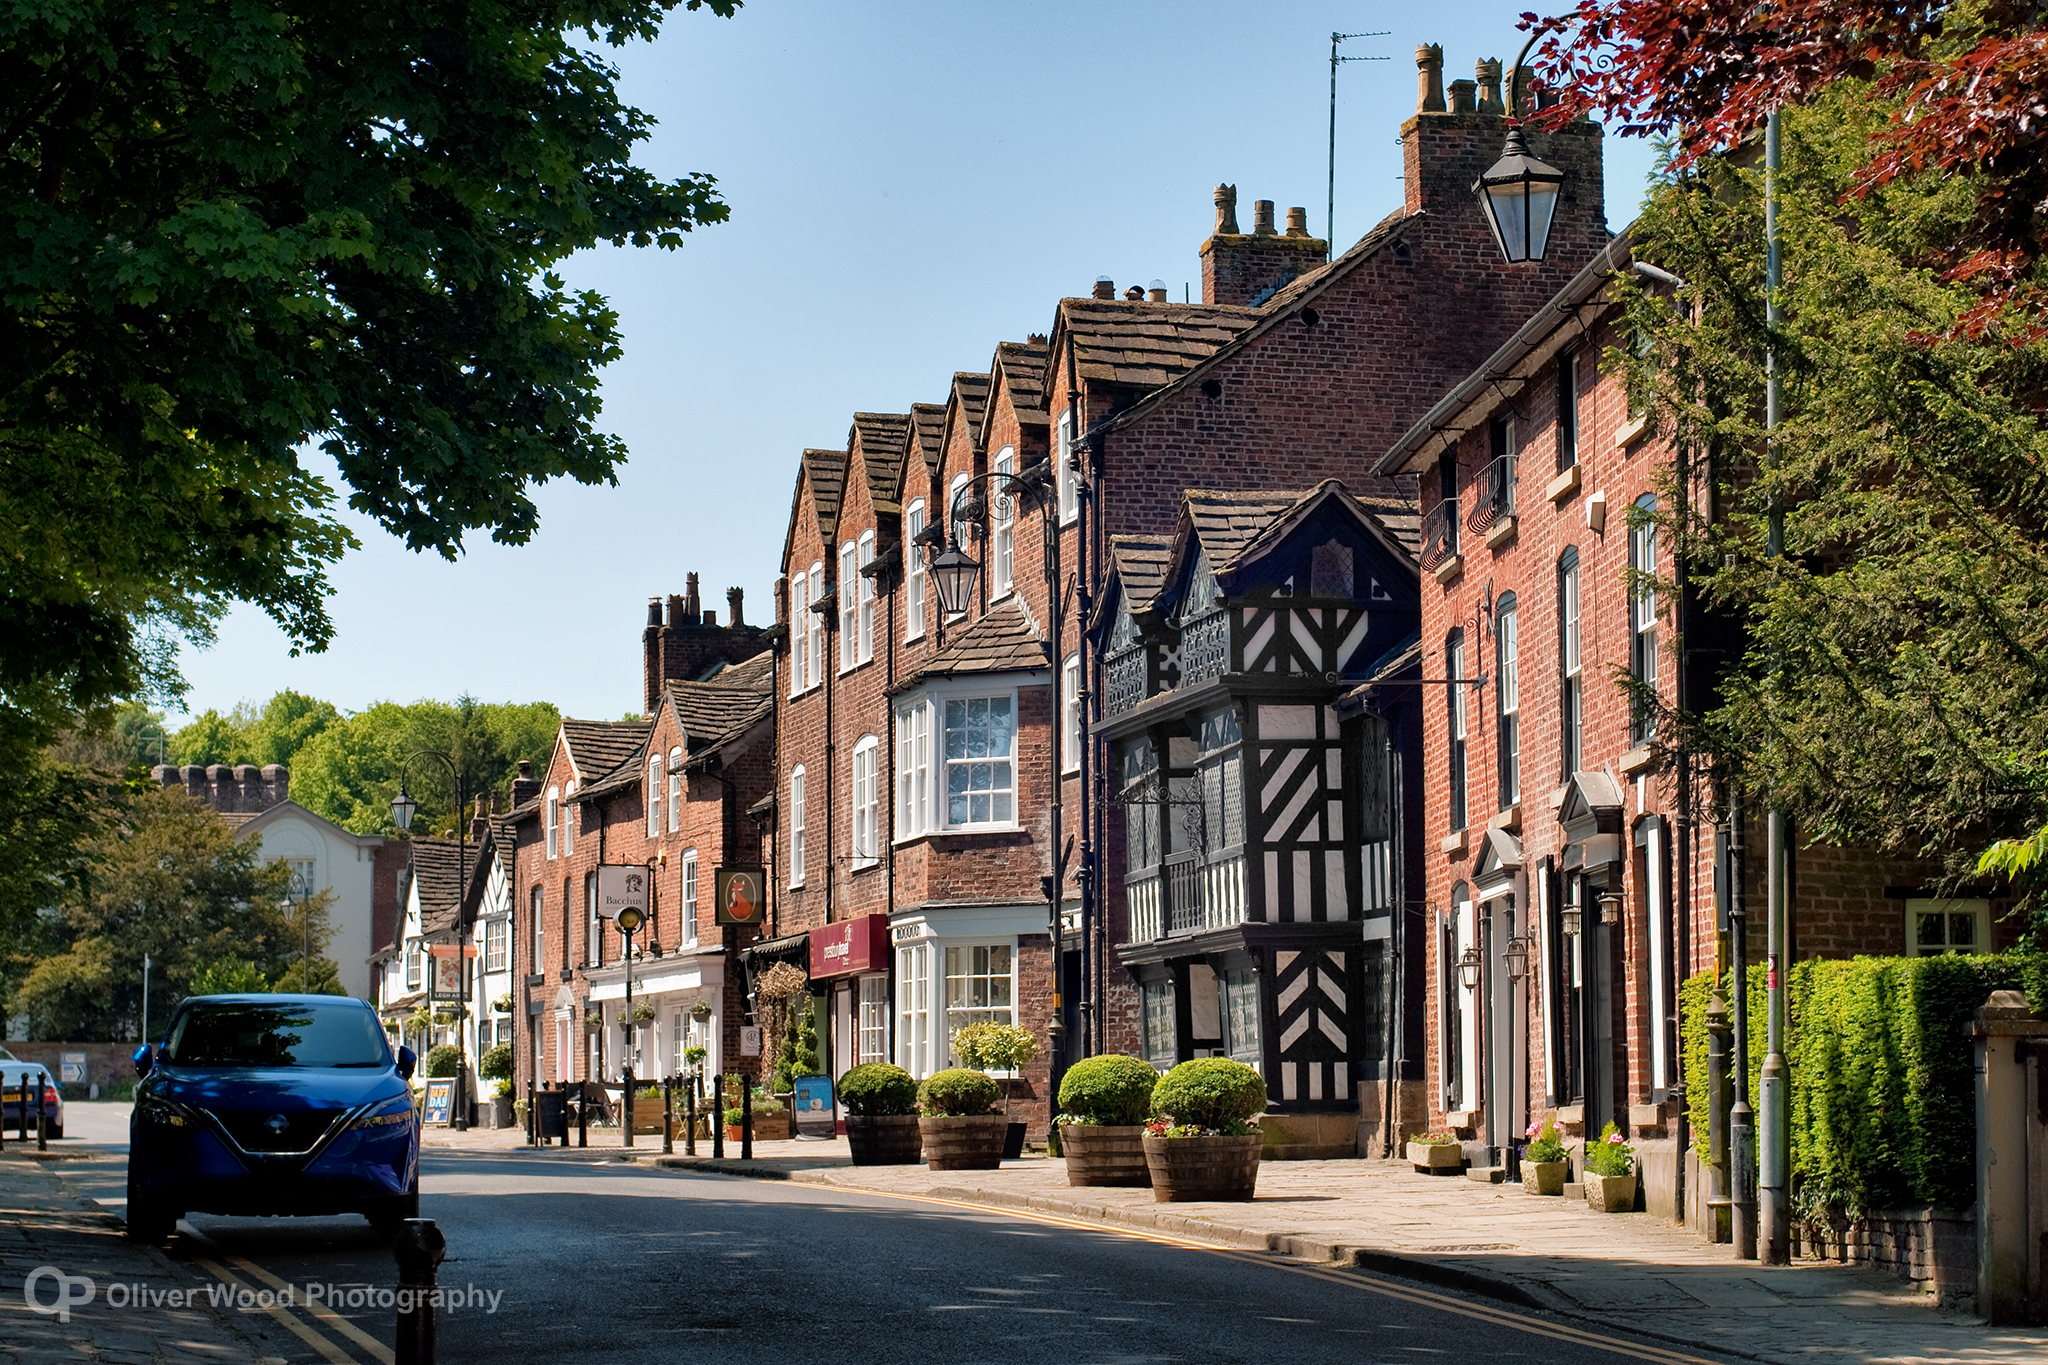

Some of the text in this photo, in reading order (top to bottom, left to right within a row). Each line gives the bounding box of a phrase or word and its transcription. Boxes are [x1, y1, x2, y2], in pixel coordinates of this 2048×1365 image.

[606, 896, 642, 905] Bacchus
[430, 1088, 449, 1097] DAD'S
[429, 1097, 448, 1108] DAY
